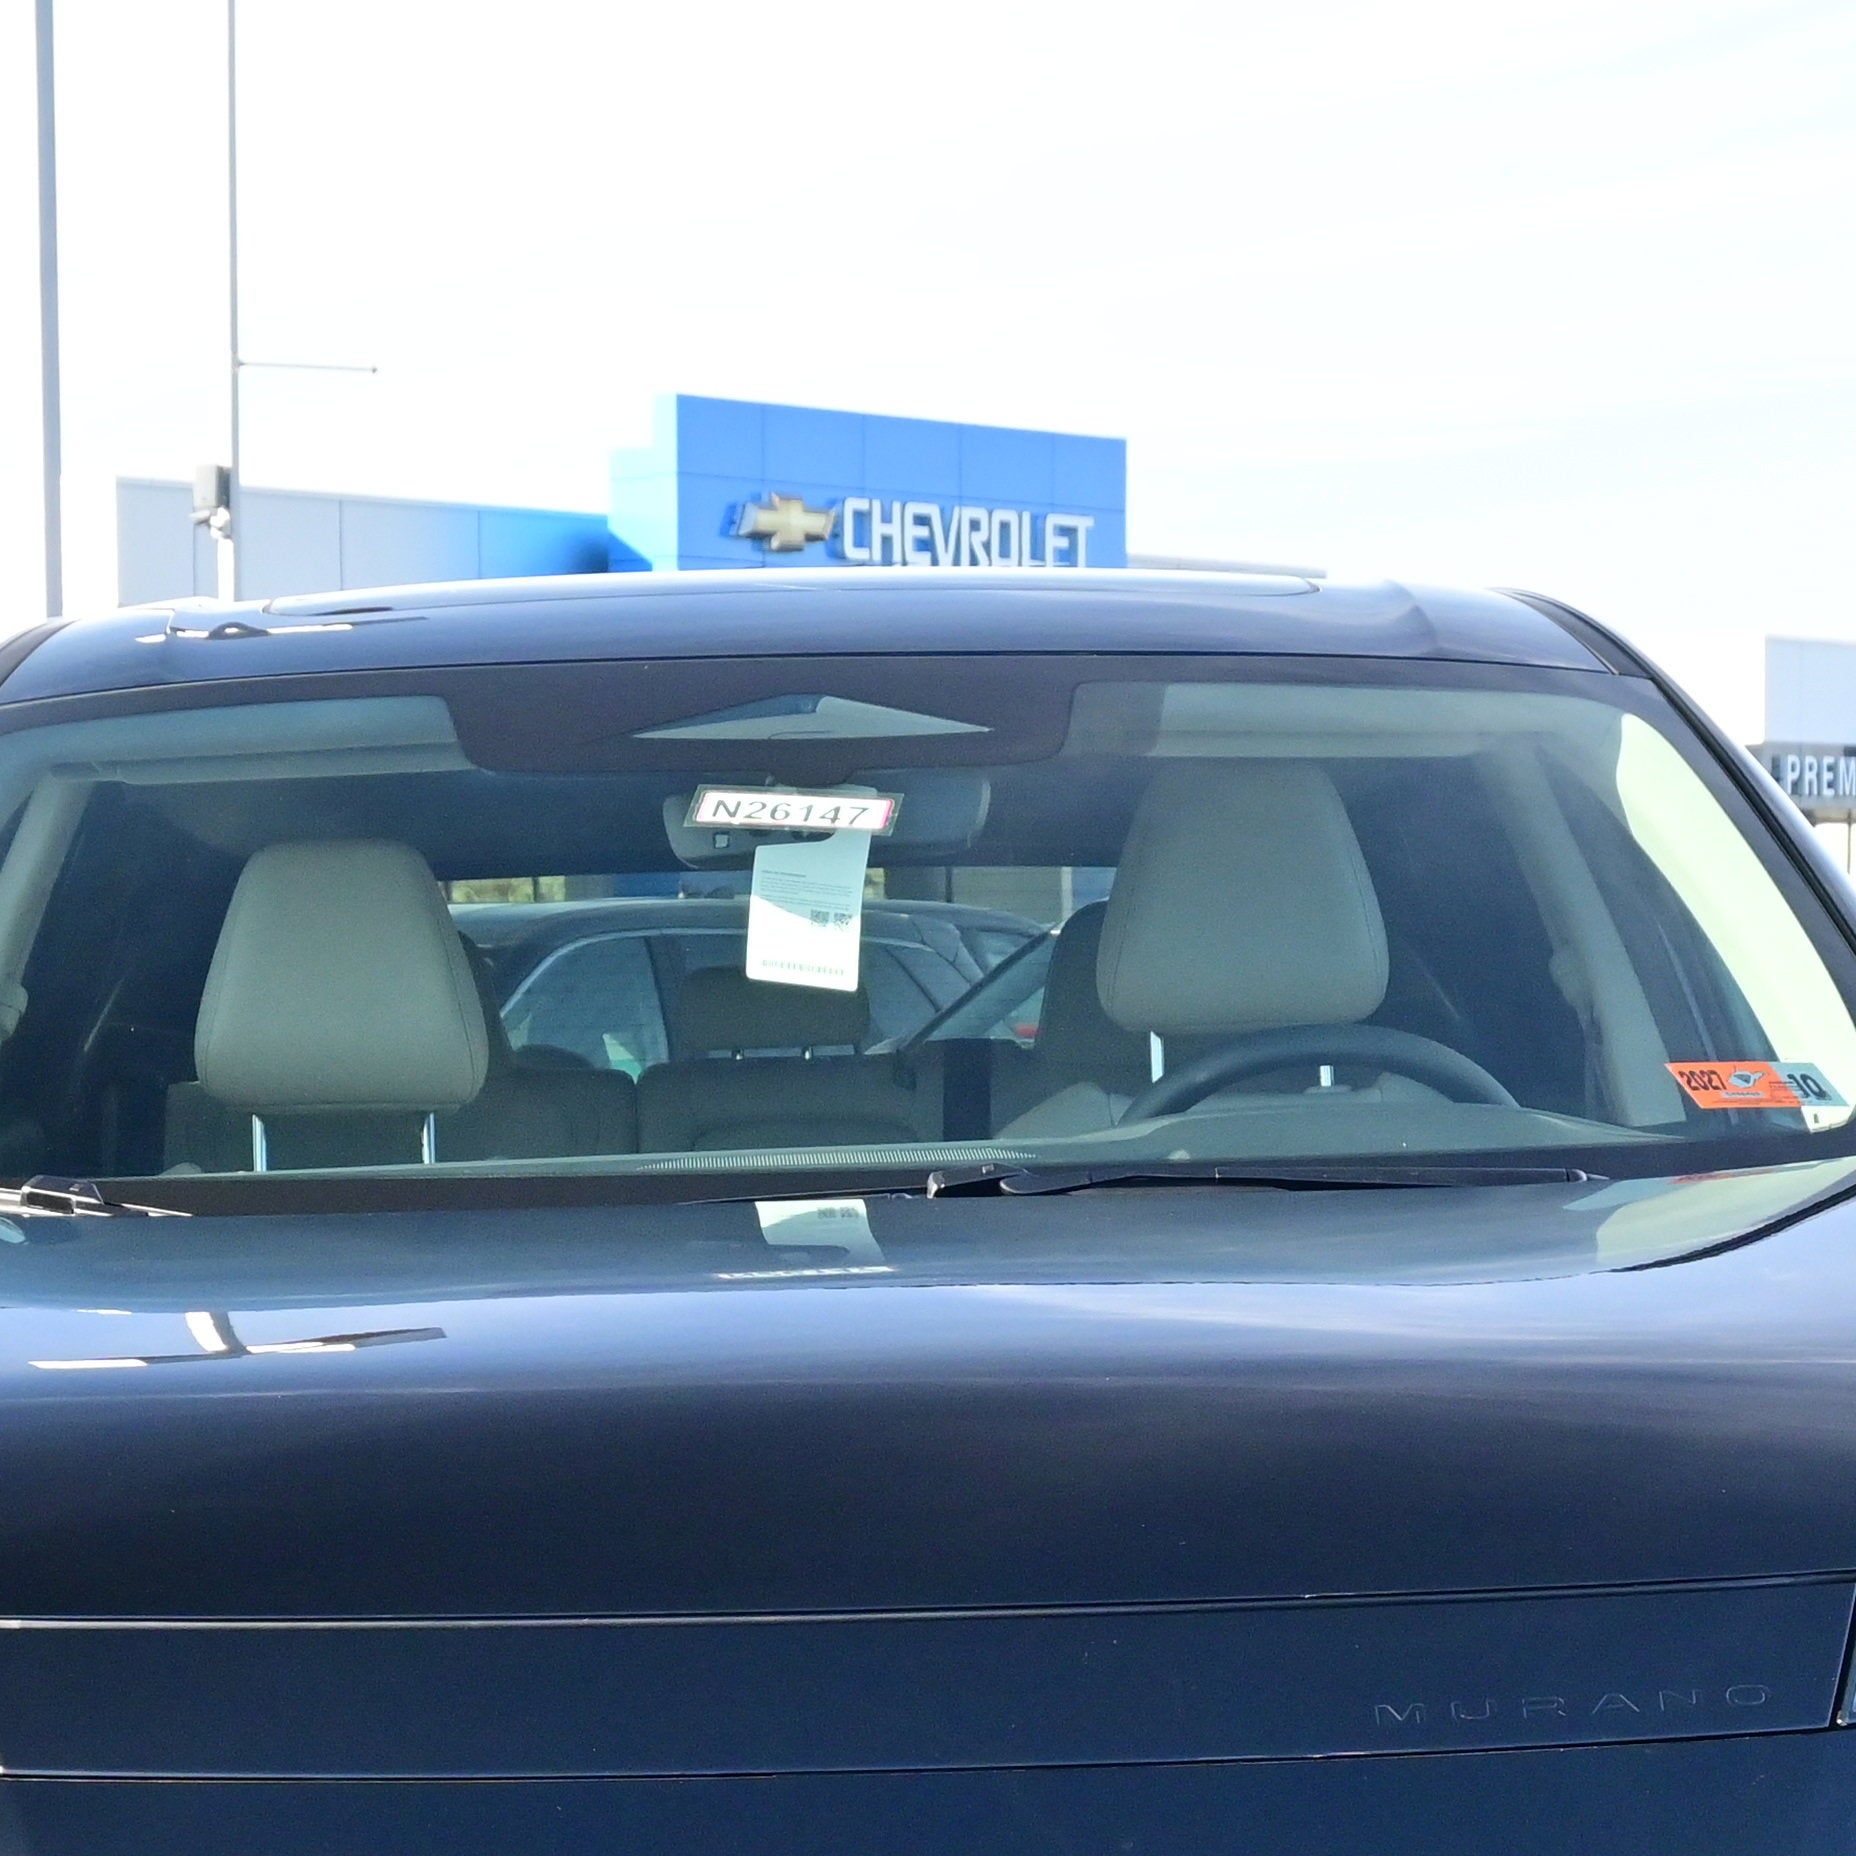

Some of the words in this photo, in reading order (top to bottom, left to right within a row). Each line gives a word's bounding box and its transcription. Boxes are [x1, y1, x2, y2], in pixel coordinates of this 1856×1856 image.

[843, 496, 1095, 568] CHEVROLET
[711, 799, 870, 825] N26147
[1678, 1069, 1728, 1091] 2027
[1374, 1684, 1772, 1725] MURANO
